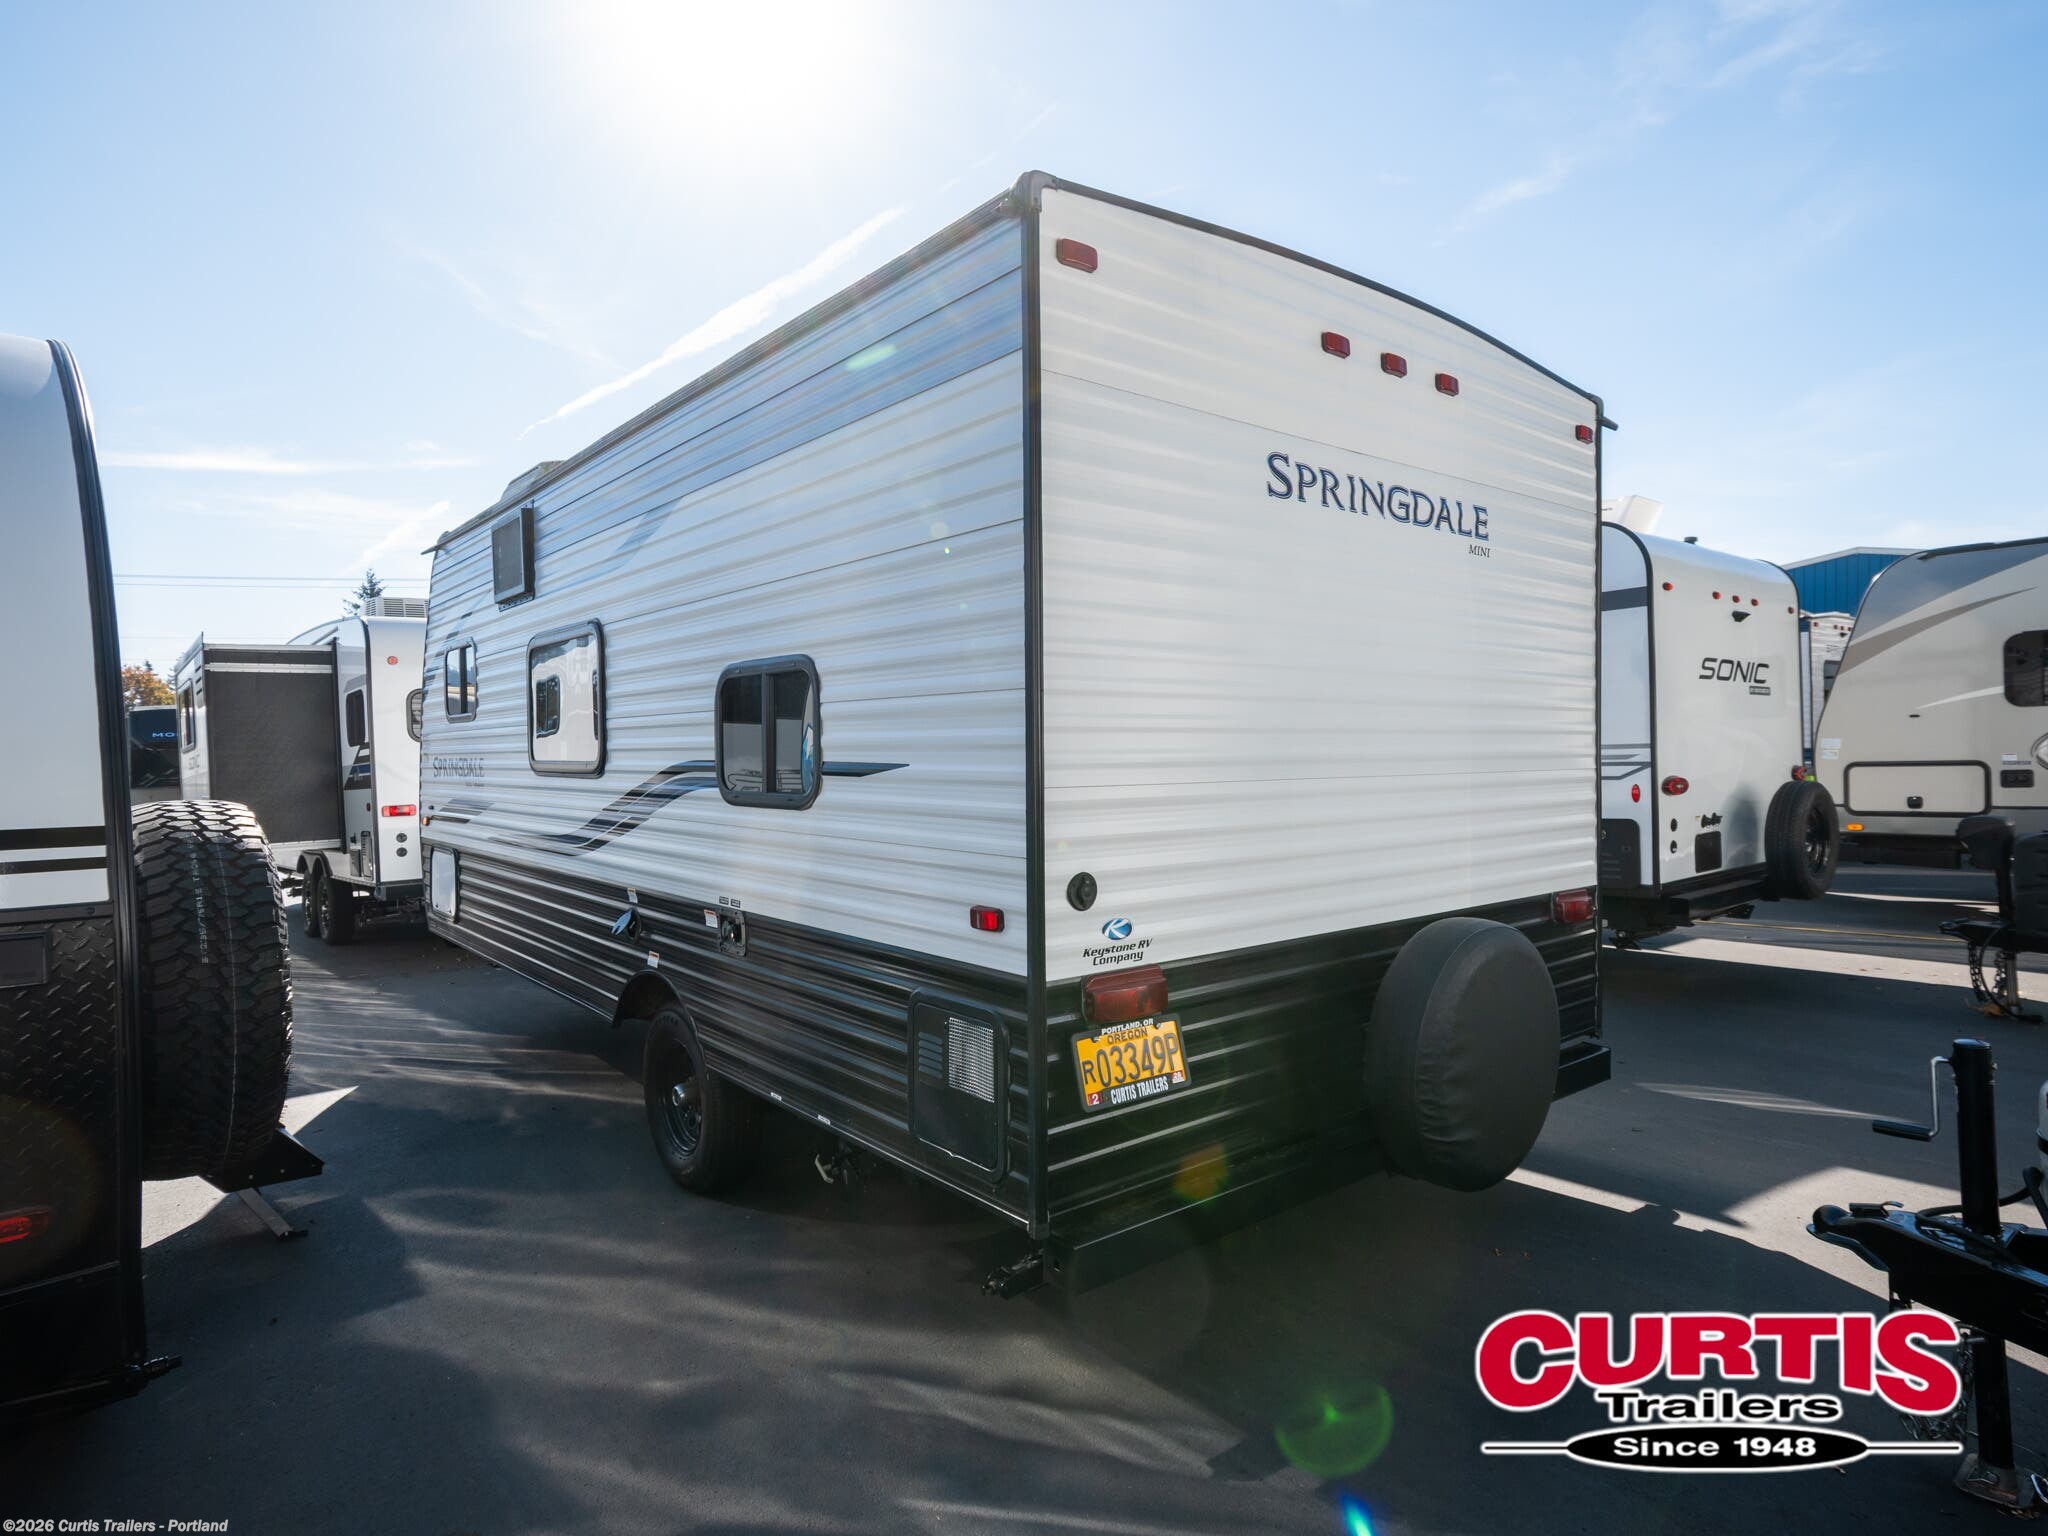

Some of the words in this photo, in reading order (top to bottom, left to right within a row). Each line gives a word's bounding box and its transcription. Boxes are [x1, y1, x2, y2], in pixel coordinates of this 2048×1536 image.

[1266, 451, 1489, 541] SPRINGDALE
[1468, 544, 1491, 558] MINI
[1699, 657, 1769, 684] SONIC
[433, 757, 485, 777] SPRINGDALE
[1083, 942, 1136, 959] Keystone
[1138, 938, 1152, 949] RV
[1093, 951, 1144, 966] Company
[1143, 1018, 1154, 1026] OR
[1107, 1028, 1148, 1044] OREGON
[1092, 1094, 1099, 1105] 2
[1111, 1083, 1136, 1105] CURTIS
[1137, 1076, 1169, 1098] TRAILERS
